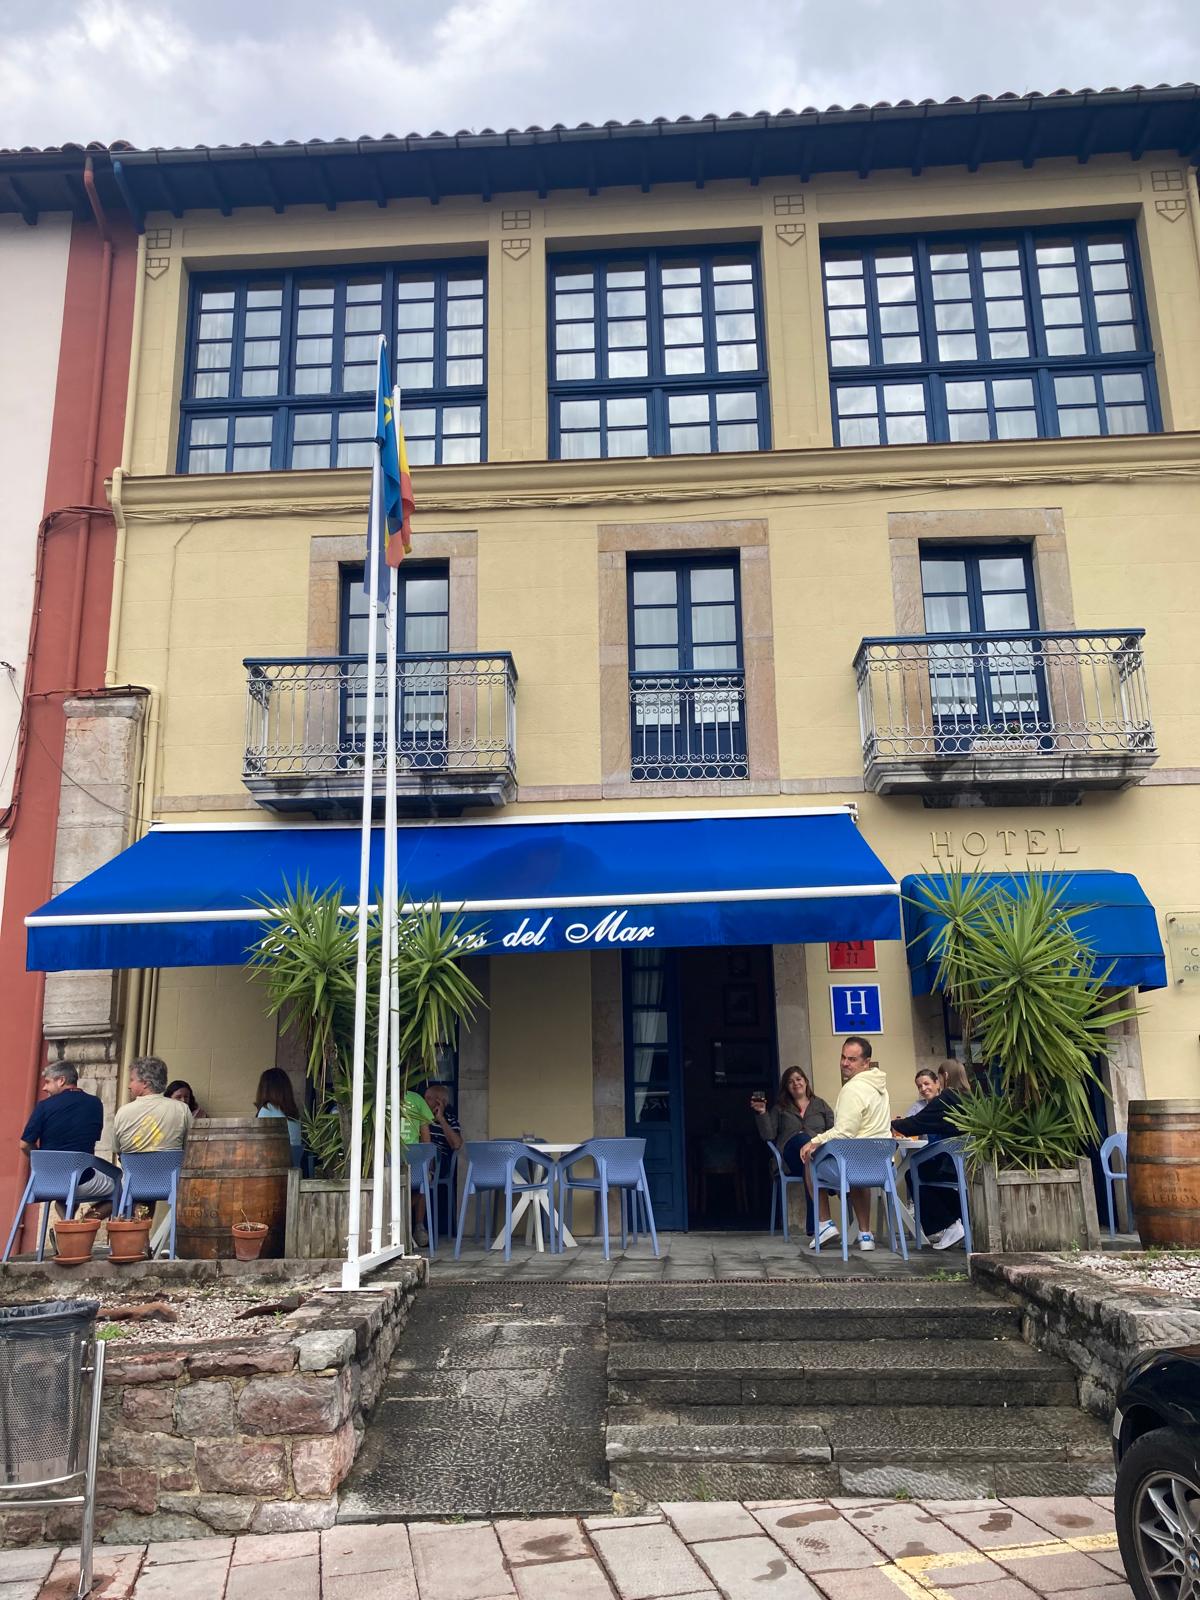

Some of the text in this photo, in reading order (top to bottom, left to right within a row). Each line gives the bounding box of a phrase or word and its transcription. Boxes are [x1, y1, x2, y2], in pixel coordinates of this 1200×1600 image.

[930, 828, 1080, 858] HOTEL
[502, 916, 553, 947] del
[565, 910, 655, 943] Mar
[843, 990, 869, 1015] H
